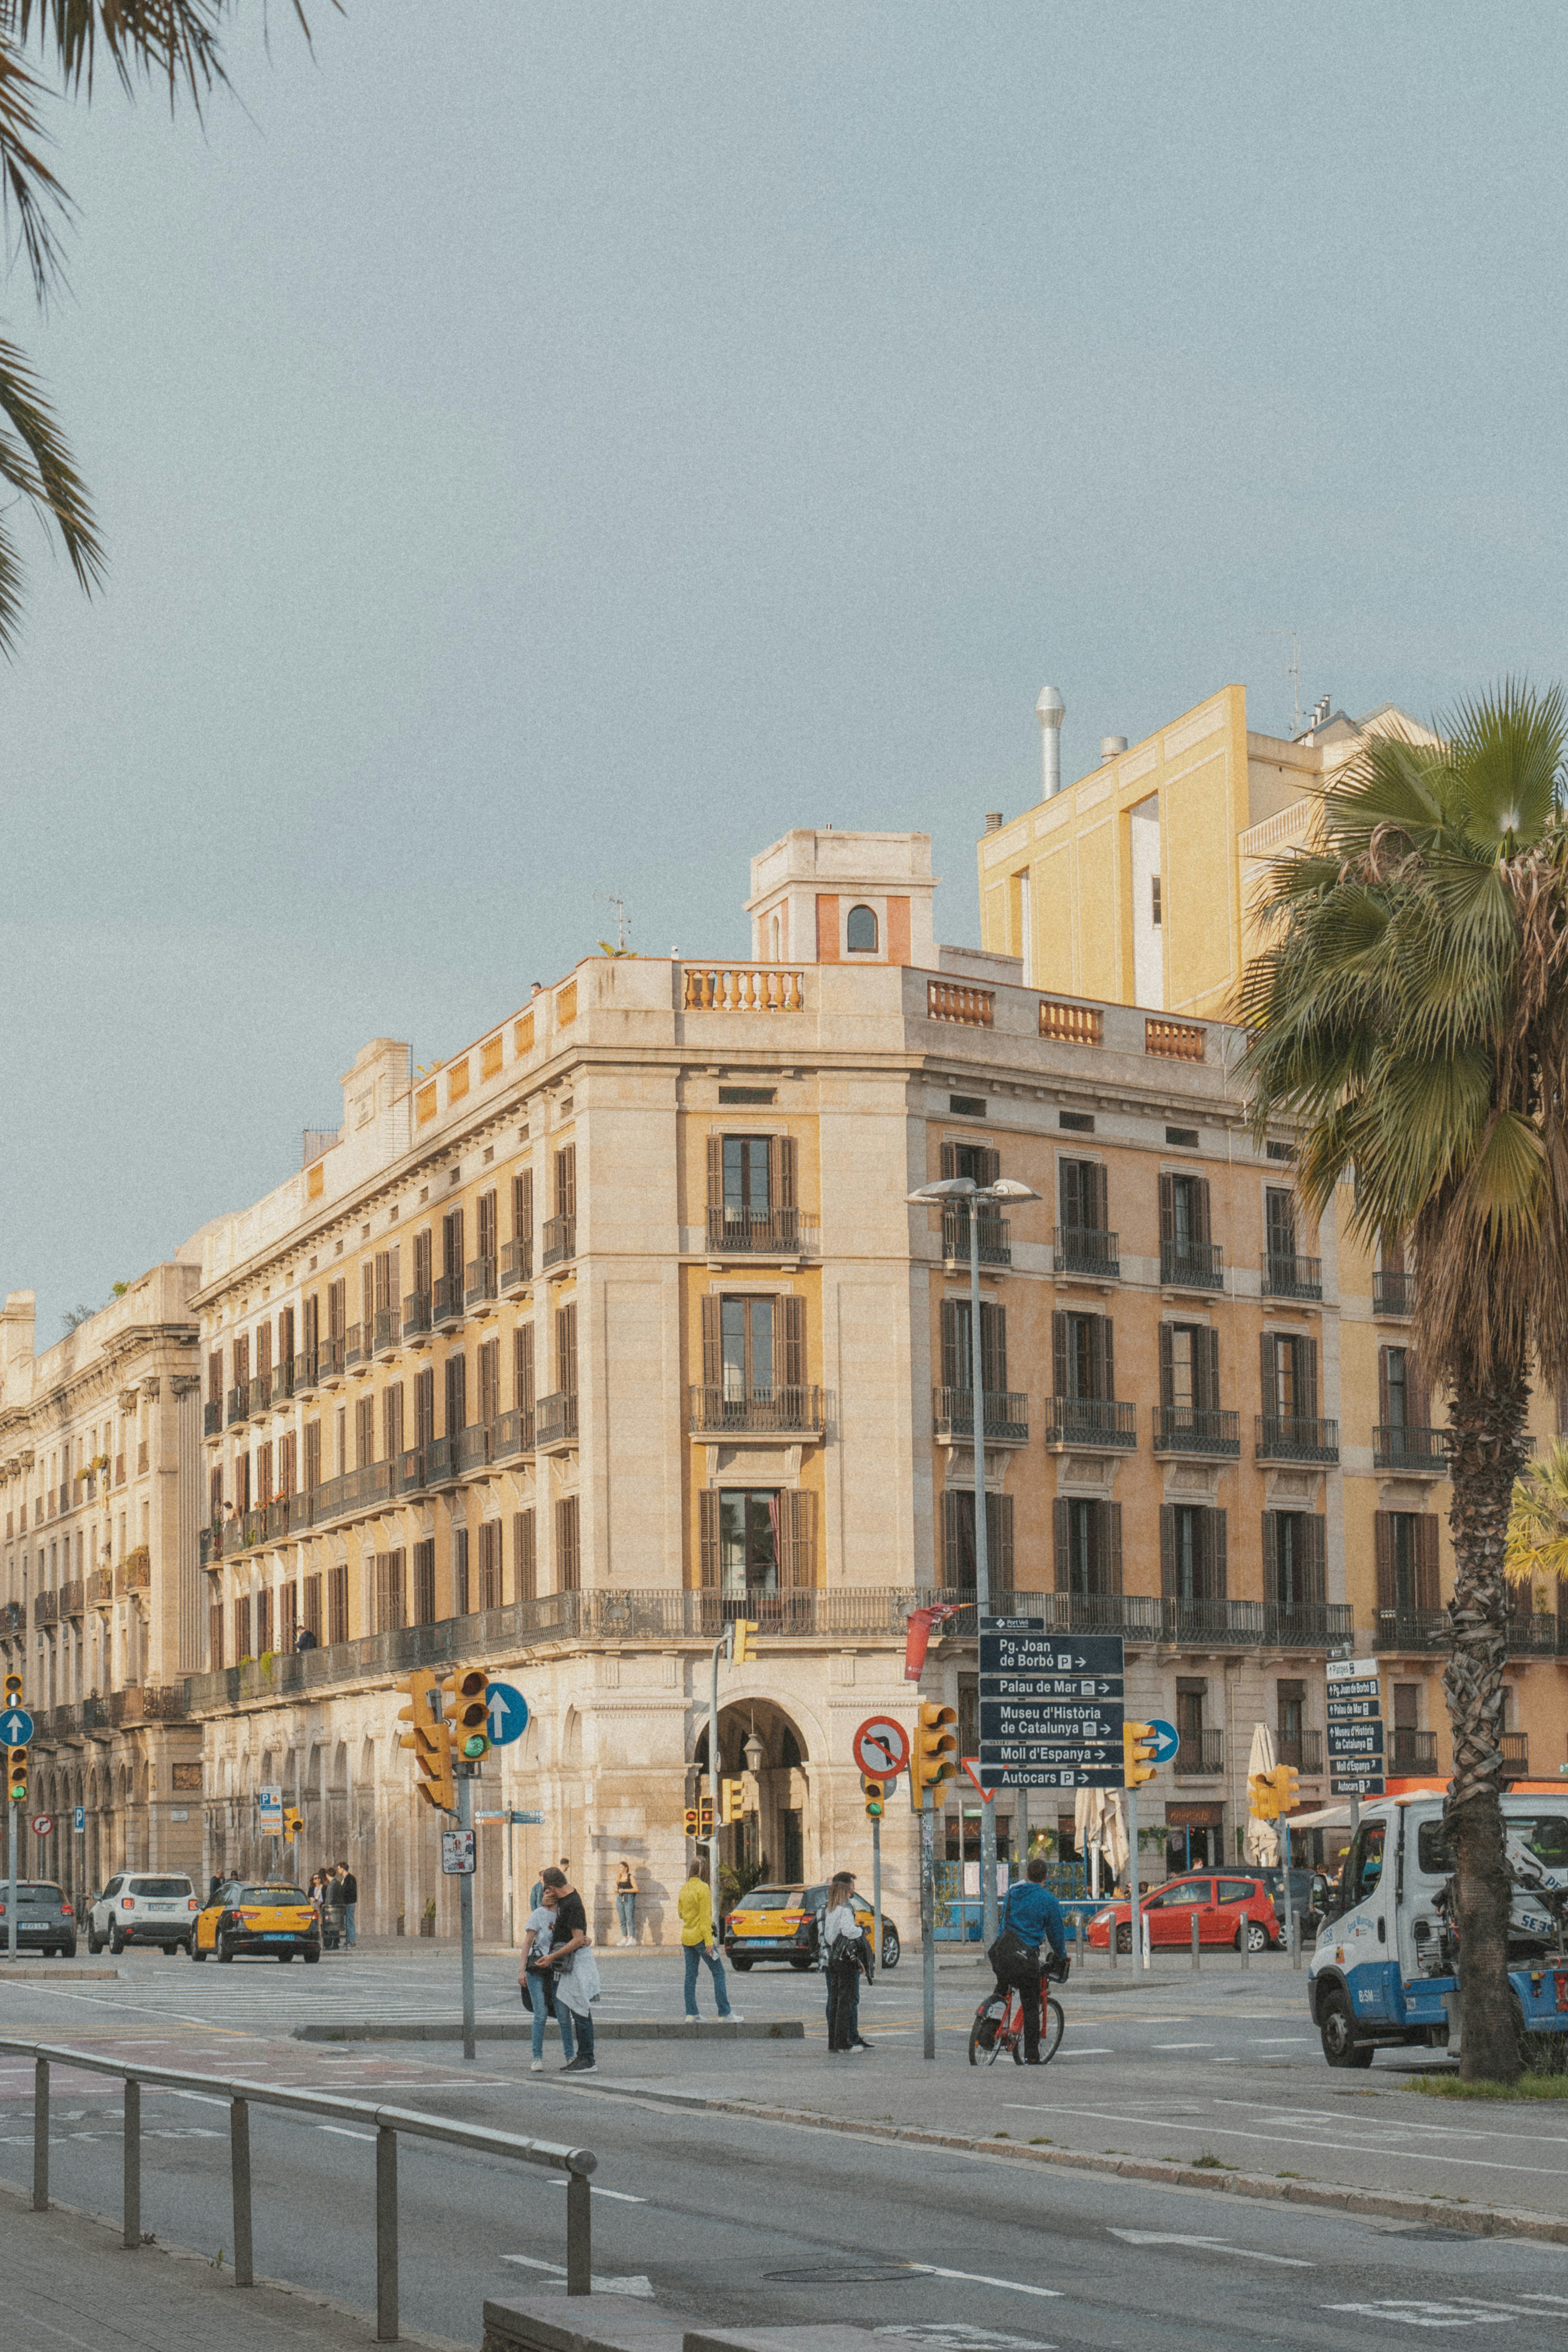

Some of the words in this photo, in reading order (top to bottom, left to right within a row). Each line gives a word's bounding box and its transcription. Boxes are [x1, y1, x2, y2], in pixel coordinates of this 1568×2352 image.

[1000, 1639, 1019, 1654] Pg.
[1022, 1640, 1050, 1652] Joan
[1000, 1655, 1014, 1666] de
[1018, 1654, 1054, 1667] Borbó
[1333, 1665, 1348, 1676] Platges
[1000, 1681, 1033, 1693] Palau
[1036, 1681, 1051, 1693] de
[1054, 1681, 1077, 1693] Mar
[1340, 1684, 1350, 1695] Joan
[1351, 1683, 1356, 1693] de
[1356, 1682, 1369, 1693] Borbó
[1000, 1707, 1039, 1719] Museu
[1043, 1707, 1101, 1719] d'Història
[1334, 1704, 1346, 1715] Palau
[1347, 1703, 1353, 1714] de
[1353, 1703, 1362, 1714] Mar
[1001, 1722, 1015, 1733] de
[1019, 1722, 1079, 1736] Catalunya
[1334, 1726, 1350, 1737] Museu
[1351, 1724, 1374, 1736] d'Història
[1336, 1739, 1341, 1749] de
[1342, 1738, 1366, 1751] Catalunya
[1001, 1747, 1026, 1759] Moll
[1029, 1747, 1091, 1762] d'Espanya
[1336, 1761, 1346, 1771] Moll
[1347, 1760, 1370, 1773] d'Espanya
[1002, 1771, 1056, 1783] Autocars
[1338, 1780, 1358, 1791] Autocars
[1323, 1928, 1333, 1943] 258
